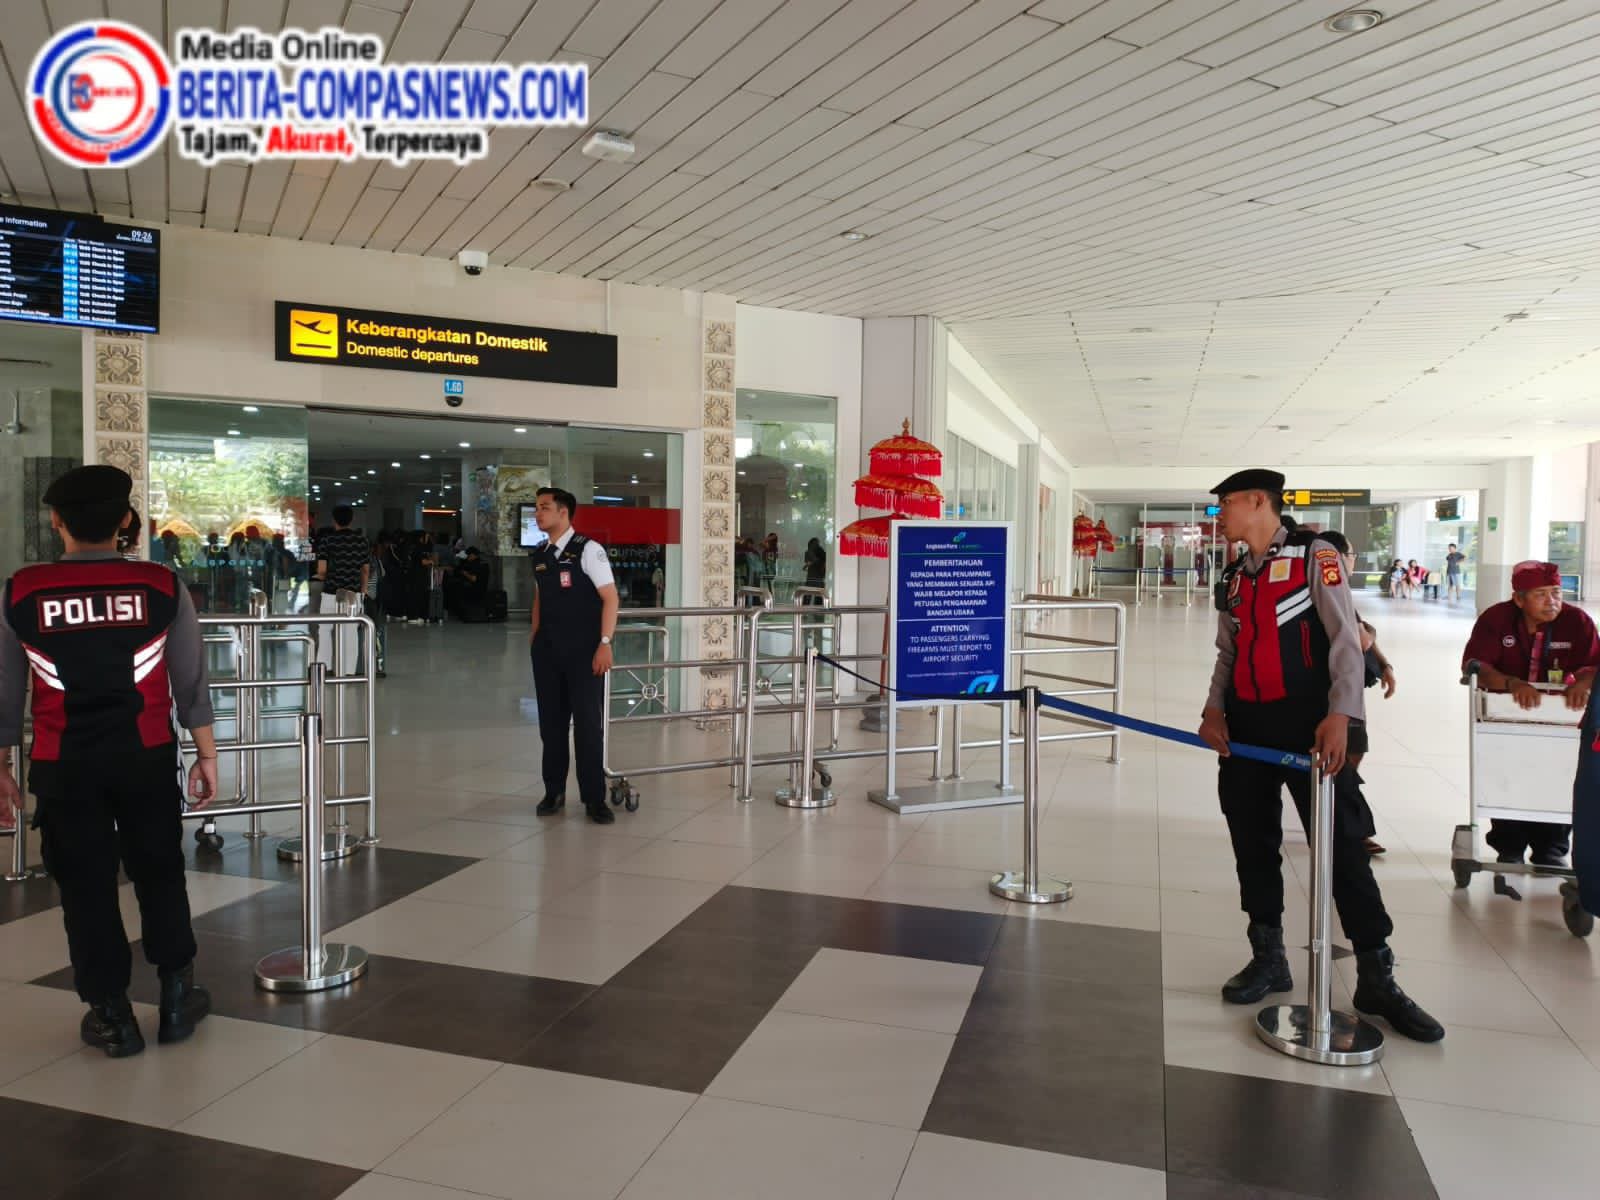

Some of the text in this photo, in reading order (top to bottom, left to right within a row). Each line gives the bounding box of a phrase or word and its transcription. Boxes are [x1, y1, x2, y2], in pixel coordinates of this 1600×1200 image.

[346, 318, 549, 352] Keberangkatan Domestik
[346, 341, 479, 365] Domestic departures
[924, 559, 983, 567] PEMBERITAHUAN
[914, 590, 933, 598] WAJIB
[964, 589, 988, 597] KEPADA
[943, 599, 987, 607] PENGAMANAN
[43, 595, 143, 627] POLISI
[953, 608, 975, 616] UDARA
[930, 624, 970, 633] ATTENTION
[920, 635, 958, 643] PASSENGERS
[959, 633, 990, 641] CARRYING
[907, 645, 939, 653] FIREARMS
[923, 654, 979, 663] AIRPORT SECURITY
